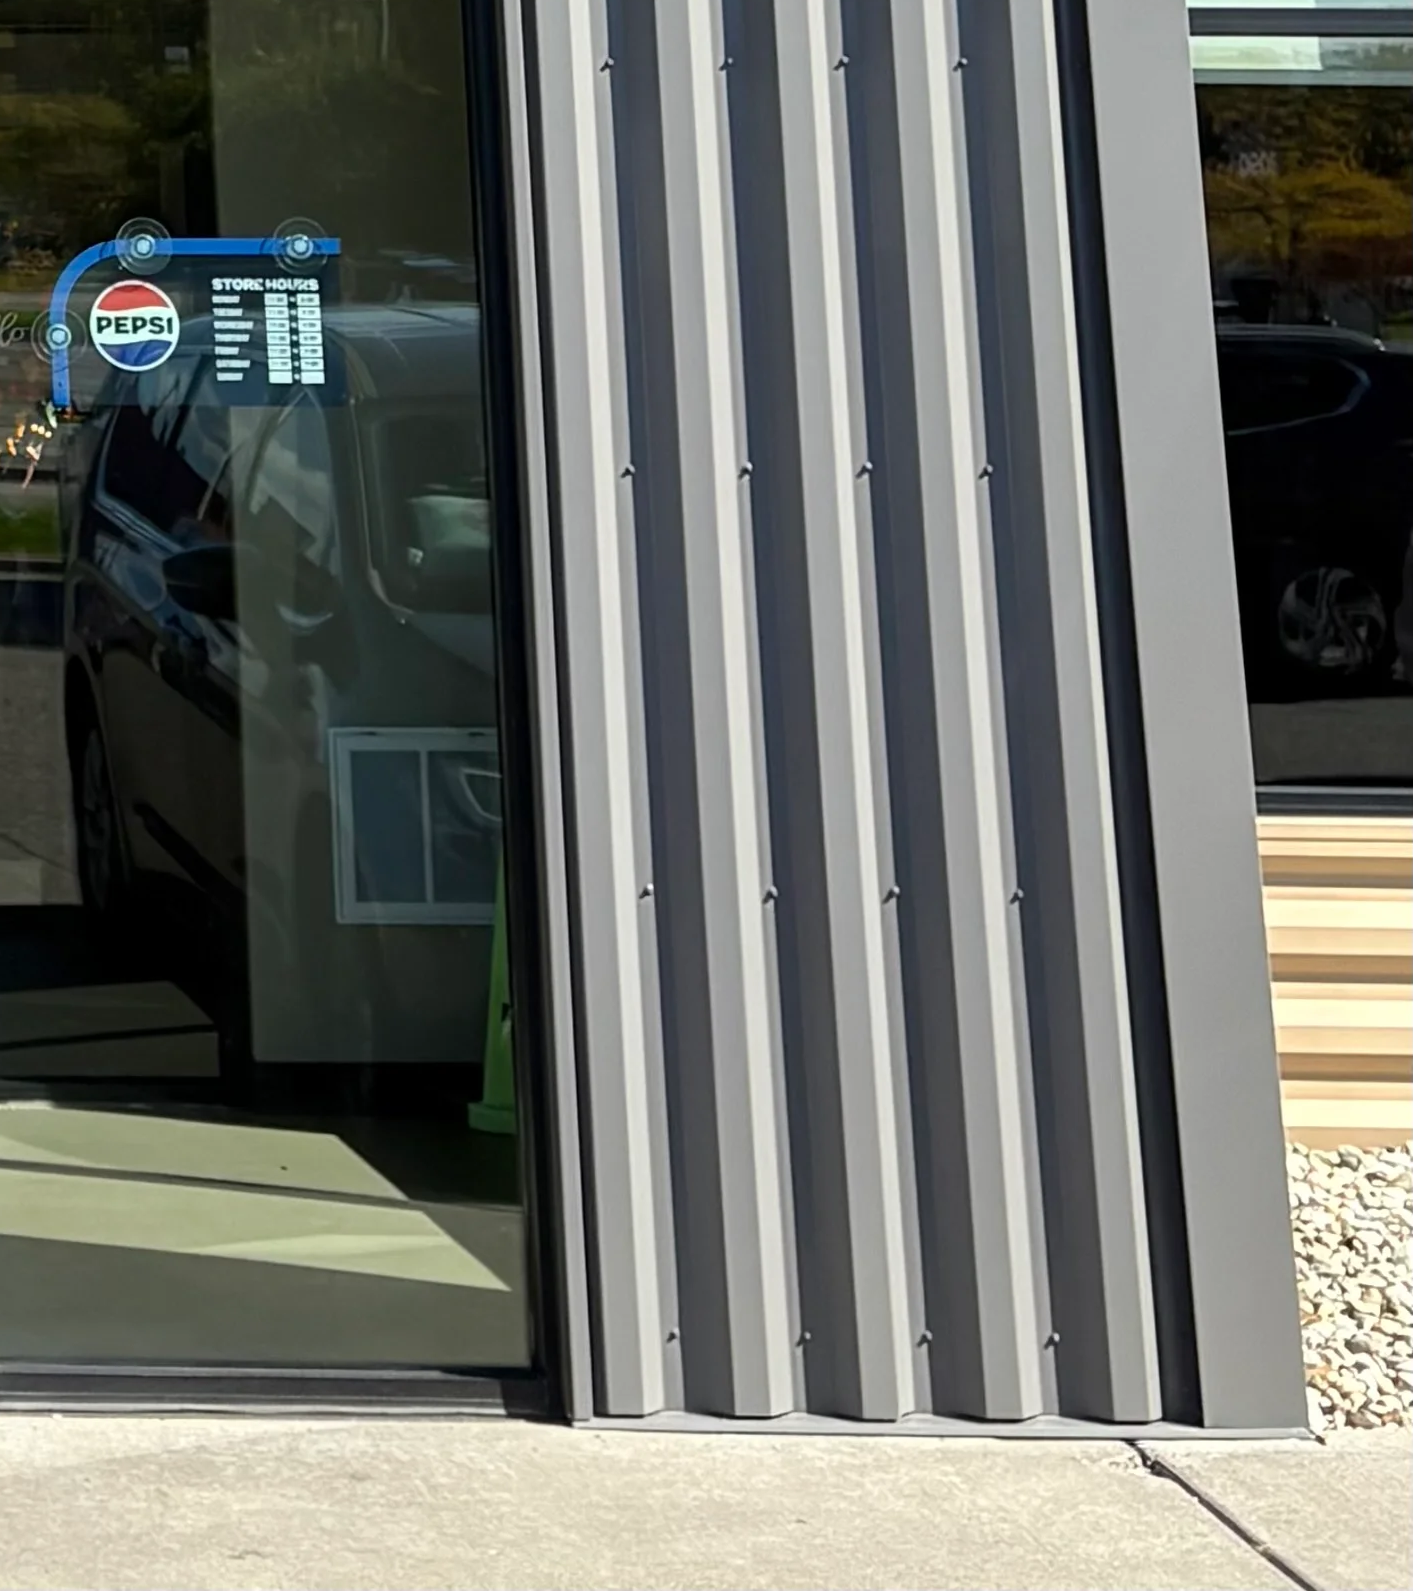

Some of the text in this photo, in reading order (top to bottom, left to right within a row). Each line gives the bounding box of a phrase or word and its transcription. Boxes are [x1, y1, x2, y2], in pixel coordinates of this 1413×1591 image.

[212, 278, 320, 291] STORE HOURS
[95, 315, 174, 335] PEPSI
